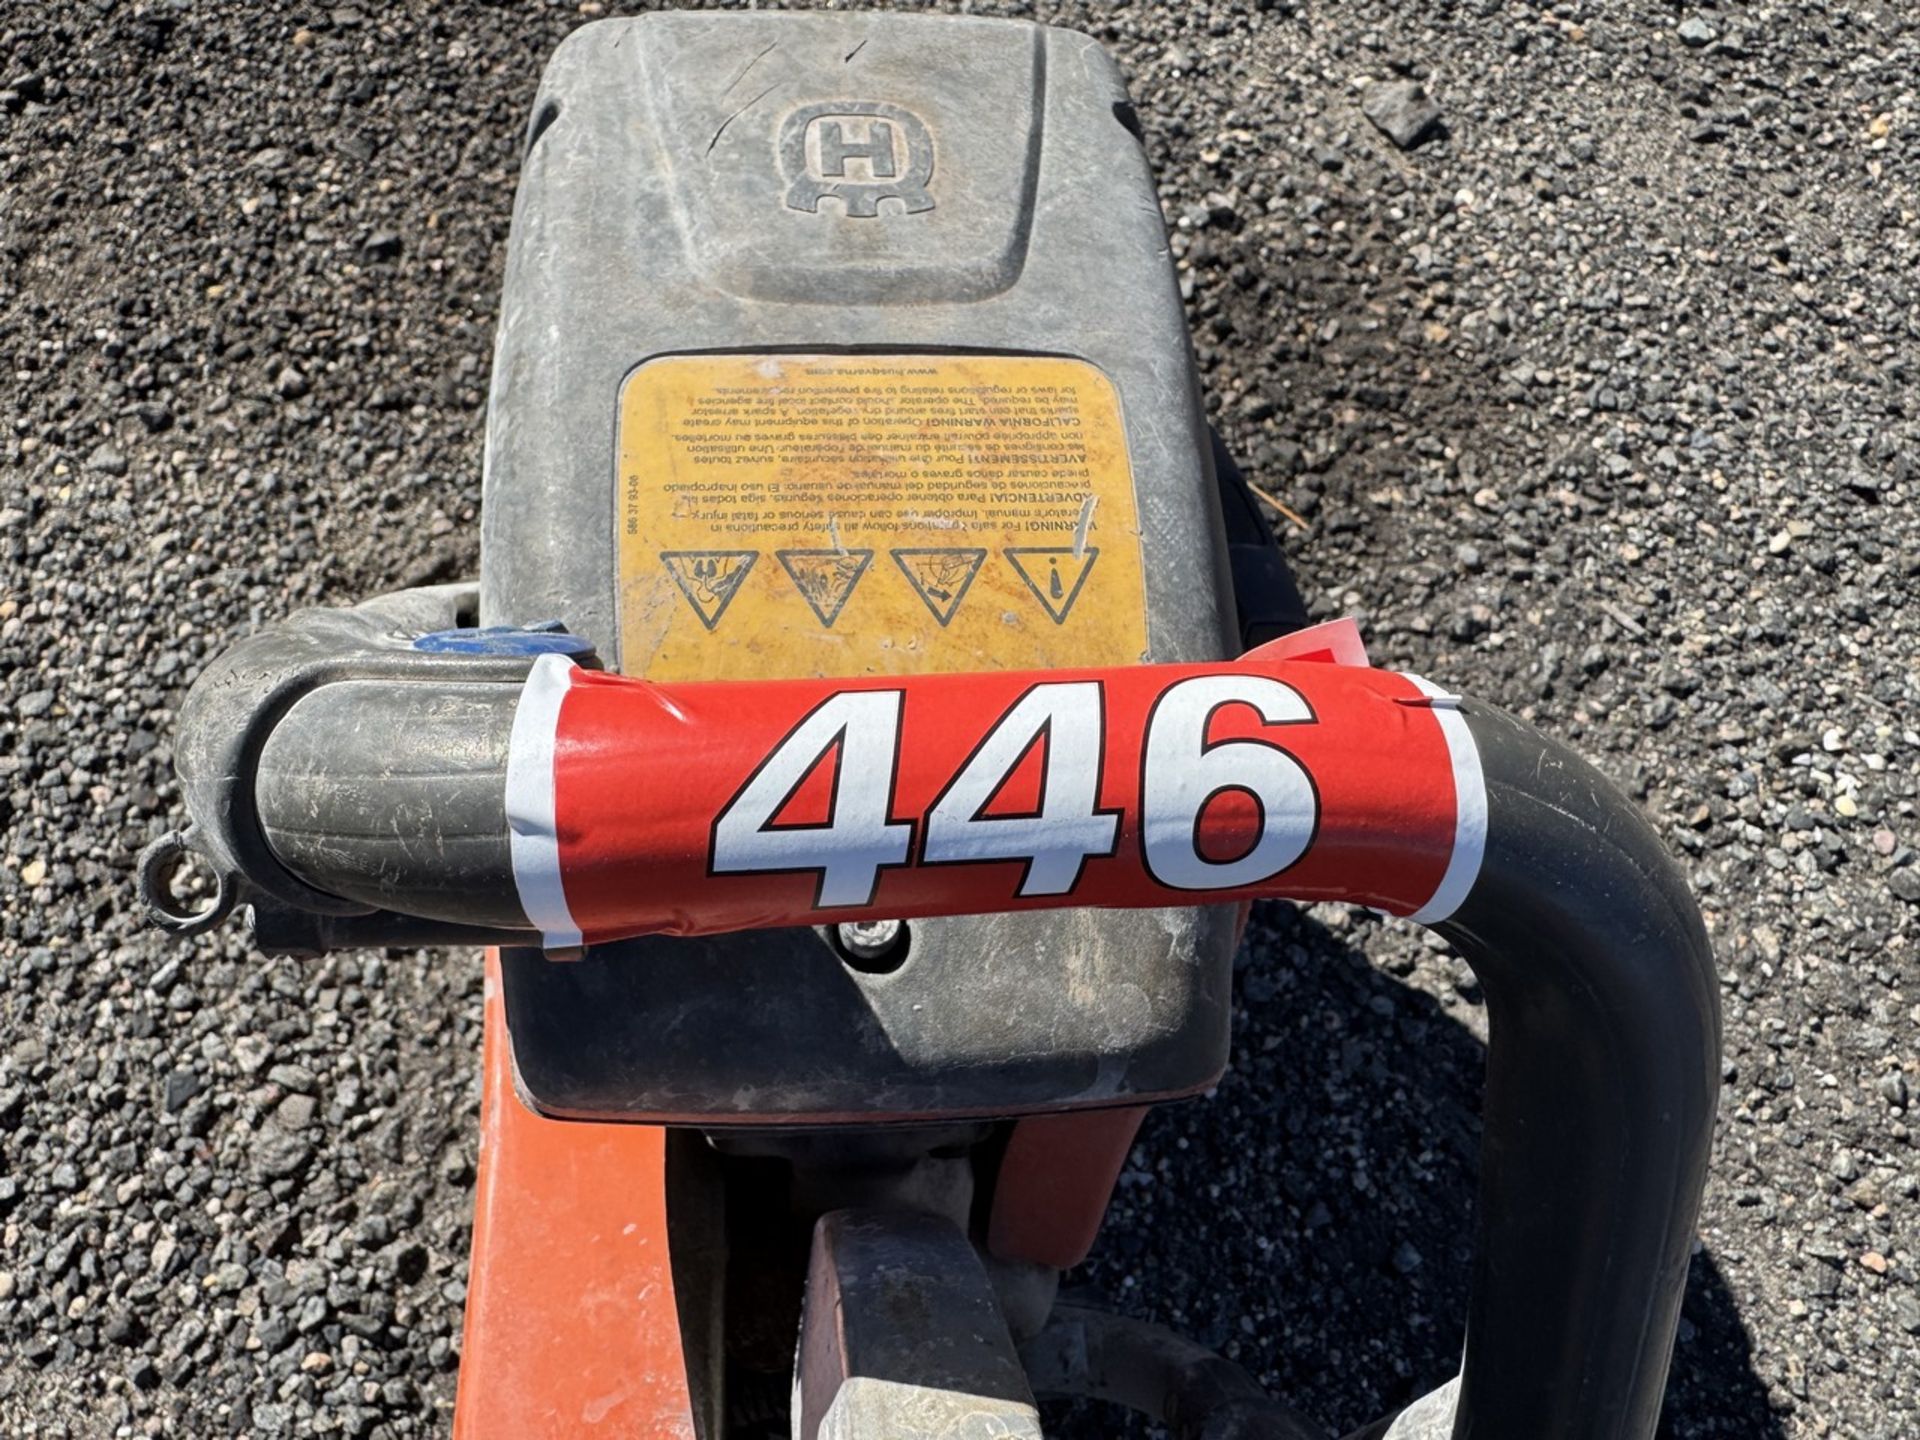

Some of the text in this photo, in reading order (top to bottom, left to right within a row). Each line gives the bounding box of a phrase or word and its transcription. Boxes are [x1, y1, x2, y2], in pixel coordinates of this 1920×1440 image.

[805, 368, 938, 376] www.husqvarna.com
[798, 386, 860, 396] prevention
[863, 387, 882, 396] fire
[886, 387, 897, 396] to
[900, 386, 944, 396] relating
[1030, 387, 1056, 395] laws
[1062, 386, 1076, 395] for
[698, 396, 752, 406] agencies
[756, 398, 774, 406] fire
[810, 398, 852, 406] contact
[856, 398, 895, 406] hould
[900, 396, 950, 406] operator
[952, 398, 974, 406] The
[1035, 397, 1049, 406] be
[1052, 395, 1078, 404] may
[692, 408, 739, 418] arrestor
[743, 407, 776, 417] spark
[780, 408, 788, 417] A
[885, 408, 926, 416] around
[930, 408, 956, 416] fires
[958, 408, 986, 416] start
[1014, 408, 1038, 416] that
[1040, 406, 1079, 416] sparks
[682, 417, 1080, 428] CALIFORNIA WARNING! Operation of this equipment may create
[672, 434, 732, 443] mortelles.
[736, 434, 752, 442] ou
[754, 432, 796, 442] graves
[1060, 432, 1084, 440] non
[686, 444, 746, 454] utilisation
[748, 444, 774, 454] Une
[848, 444, 864, 453] de
[916, 444, 930, 452] du
[985, 443, 1000, 452] de
[1003, 442, 1064, 452] consignes
[1066, 443, 1086, 452] les
[694, 456, 732, 466] toutes
[736, 456, 774, 465] suivez
[936, 454, 964, 464] Pour
[968, 454, 1086, 464] AVERTISSEMENT!
[910, 470, 918, 478] o
[922, 468, 963, 478] graves
[1007, 470, 1048, 478] causar
[1052, 468, 1090, 480] puede
[663, 482, 737, 493] inapropiado
[740, 482, 764, 491] uso
[768, 483, 780, 492] El
[837, 482, 852, 491] de
[857, 482, 902, 491] manual
[906, 482, 924, 491] del
[928, 480, 988, 491] seguridad
[992, 482, 1007, 490] de
[1010, 480, 1091, 490] precauciones
[702, 494, 737, 504] todas
[740, 492, 766, 504] siga
[827, 492, 904, 503] operaciones
[907, 493, 954, 504] obtener
[958, 493, 986, 503] Para
[732, 512, 758, 522] fatal
[762, 512, 775, 520] or
[778, 510, 824, 520] serious
[870, 510, 892, 520] can
[924, 508, 977, 521] Improper
[710, 524, 722, 533] in
[726, 521, 799, 534] precautions
[844, 523, 858, 532] all
[863, 522, 898, 532] follow
[972, 522, 998, 532] safe
[1002, 522, 1021, 531] For
[706, 674, 1321, 909] 446
